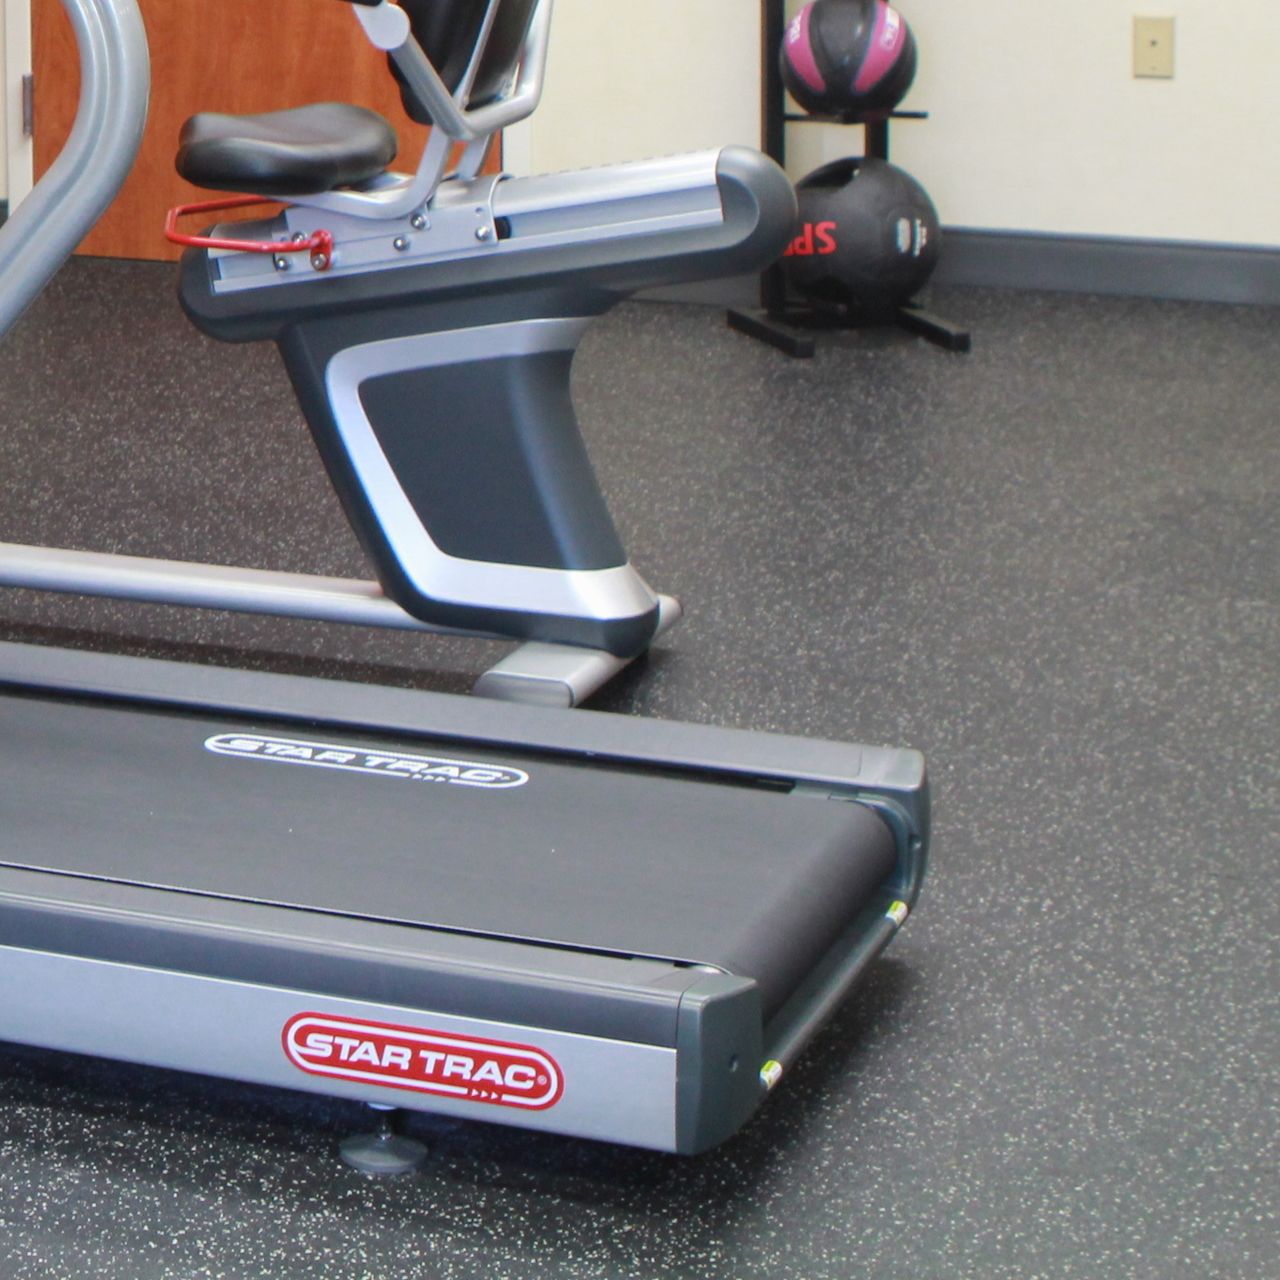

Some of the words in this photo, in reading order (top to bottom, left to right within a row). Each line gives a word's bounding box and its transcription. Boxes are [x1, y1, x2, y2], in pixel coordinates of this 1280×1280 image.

[225, 738, 357, 764] STAR
[363, 754, 503, 781] TRAC
[301, 1032, 412, 1070] STAR
